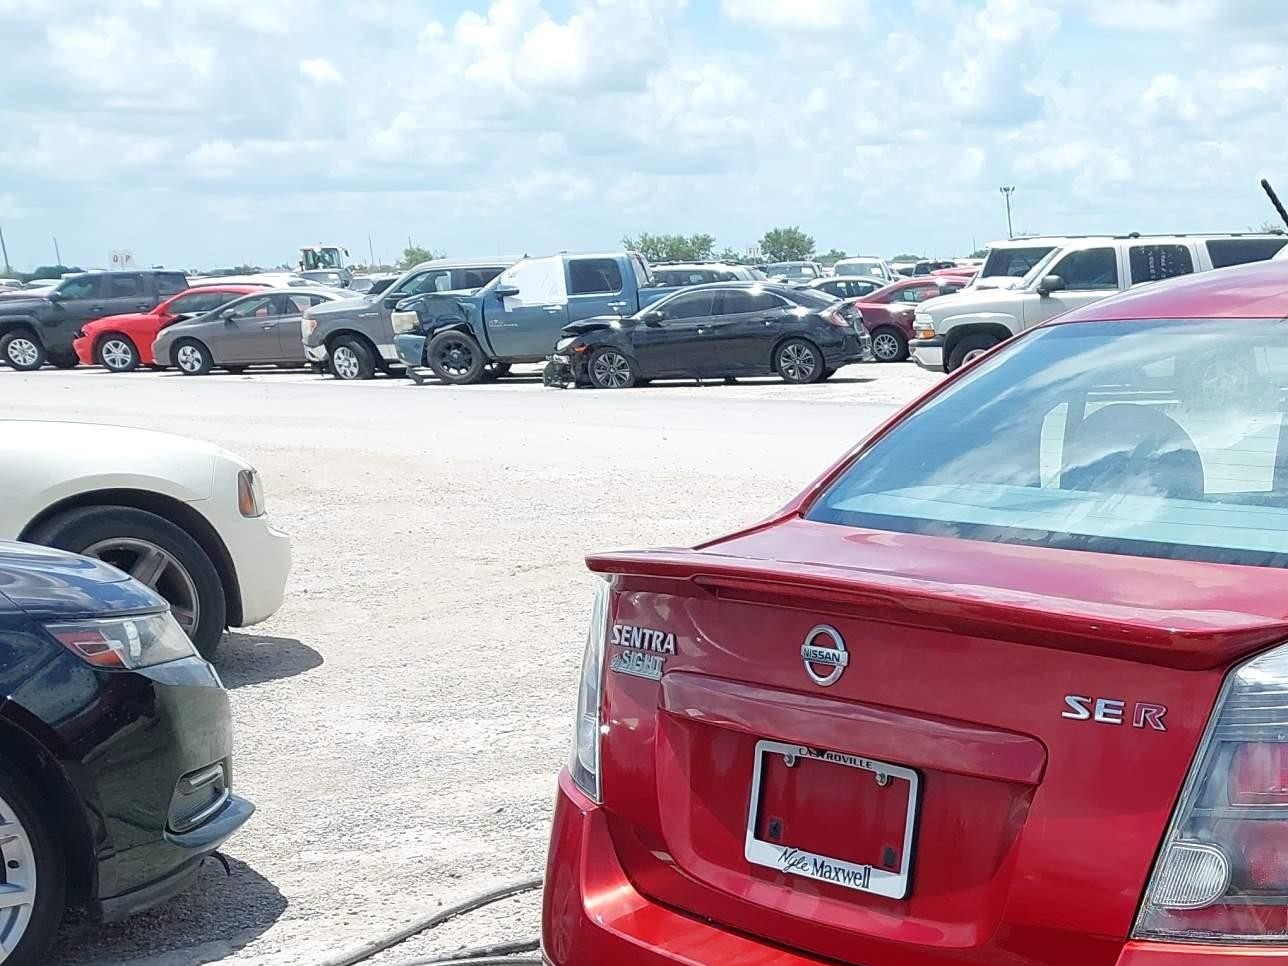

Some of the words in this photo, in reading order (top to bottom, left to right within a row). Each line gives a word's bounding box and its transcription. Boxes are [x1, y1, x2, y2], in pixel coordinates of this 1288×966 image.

[610, 624, 676, 656] SENTRA
[803, 647, 841, 662] NISSAN
[778, 847, 810, 872] Nyle
[811, 858, 872, 889] Maxwell
